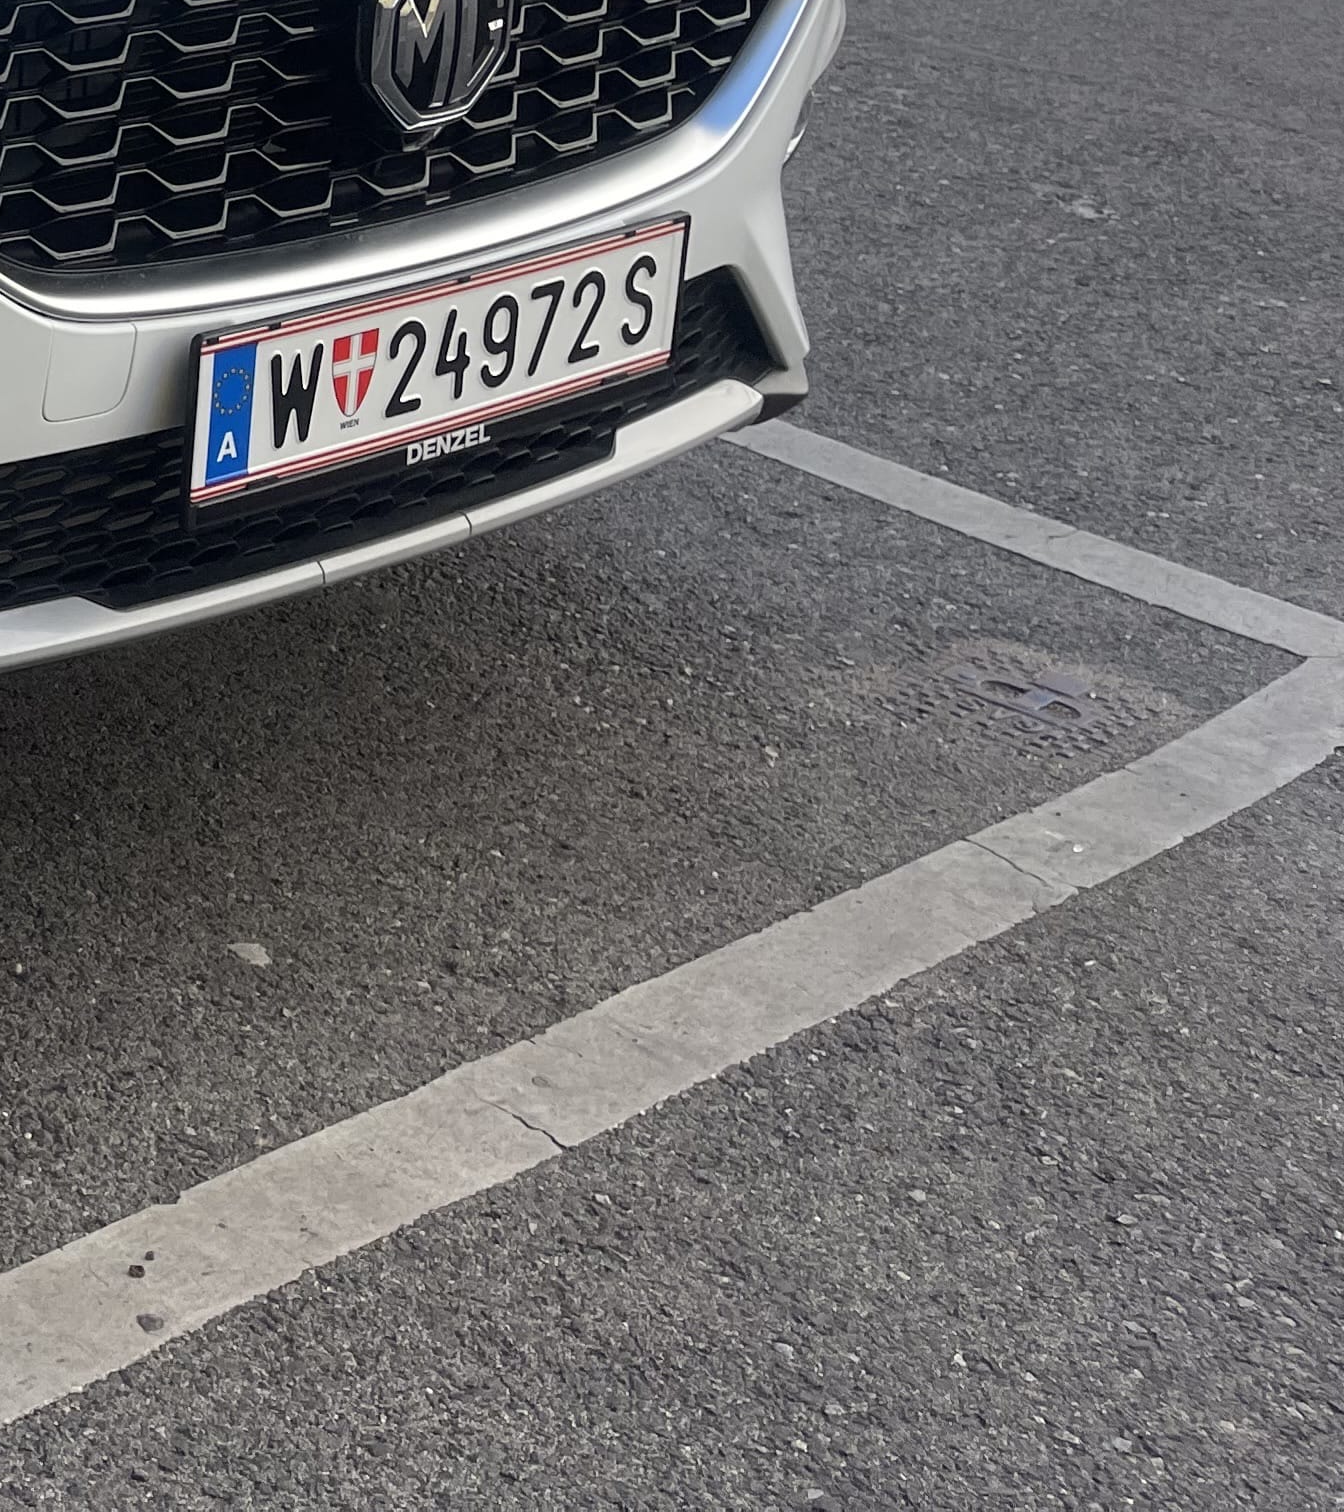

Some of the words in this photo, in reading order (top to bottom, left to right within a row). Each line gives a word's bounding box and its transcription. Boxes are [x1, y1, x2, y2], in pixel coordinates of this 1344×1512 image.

[270, 343, 324, 450] W
[339, 418, 359, 430] WIEN
[216, 432, 238, 462] A
[406, 423, 491, 466] DENZEL
